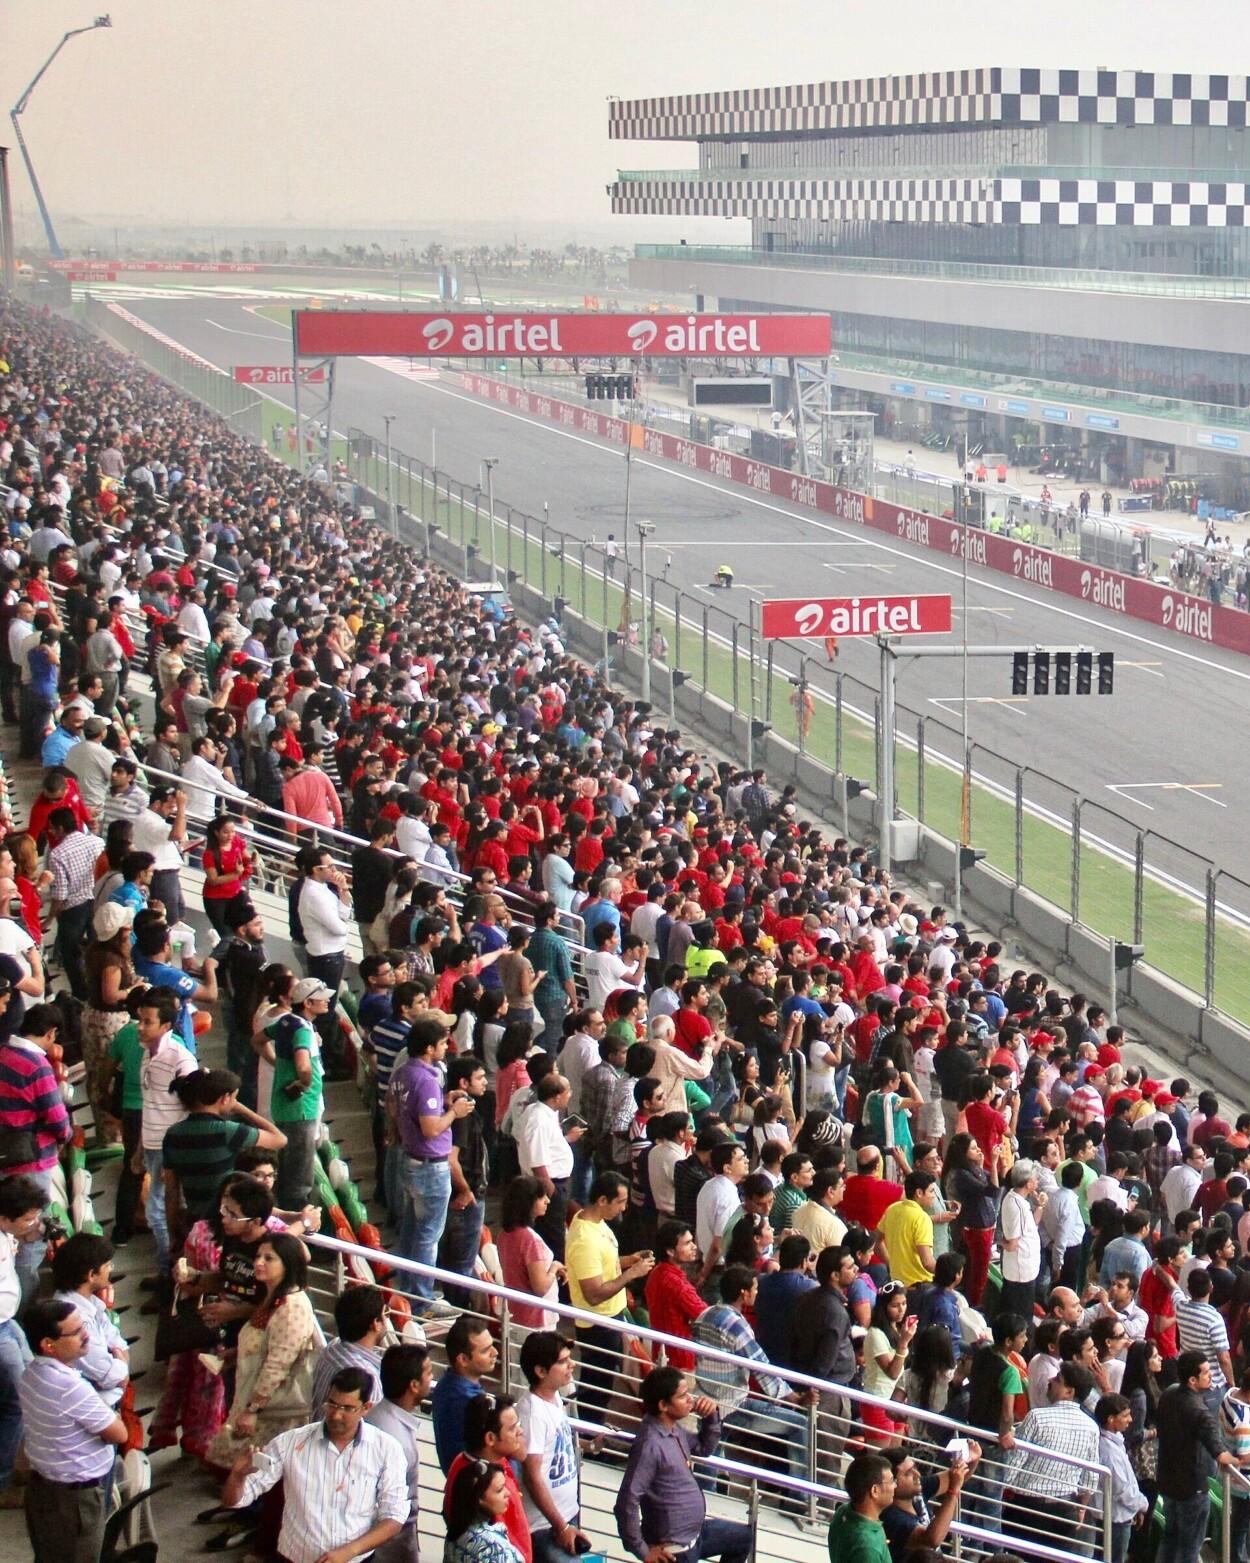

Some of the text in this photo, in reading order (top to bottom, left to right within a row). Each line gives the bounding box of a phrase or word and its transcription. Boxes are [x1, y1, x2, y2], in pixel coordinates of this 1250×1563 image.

[462, 315, 562, 352] airtel
[665, 316, 761, 352] airtel
[714, 453, 732, 479] airtel
[753, 465, 771, 492] airtel
[798, 479, 817, 507] airtel
[842, 493, 864, 523] airtel
[906, 511, 930, 545] airtel
[960, 534, 988, 566] airtel
[1023, 551, 1053, 587] airtel
[1092, 571, 1127, 611] airtel
[831, 599, 922, 633] airtel
[1175, 595, 1214, 641] airtel
